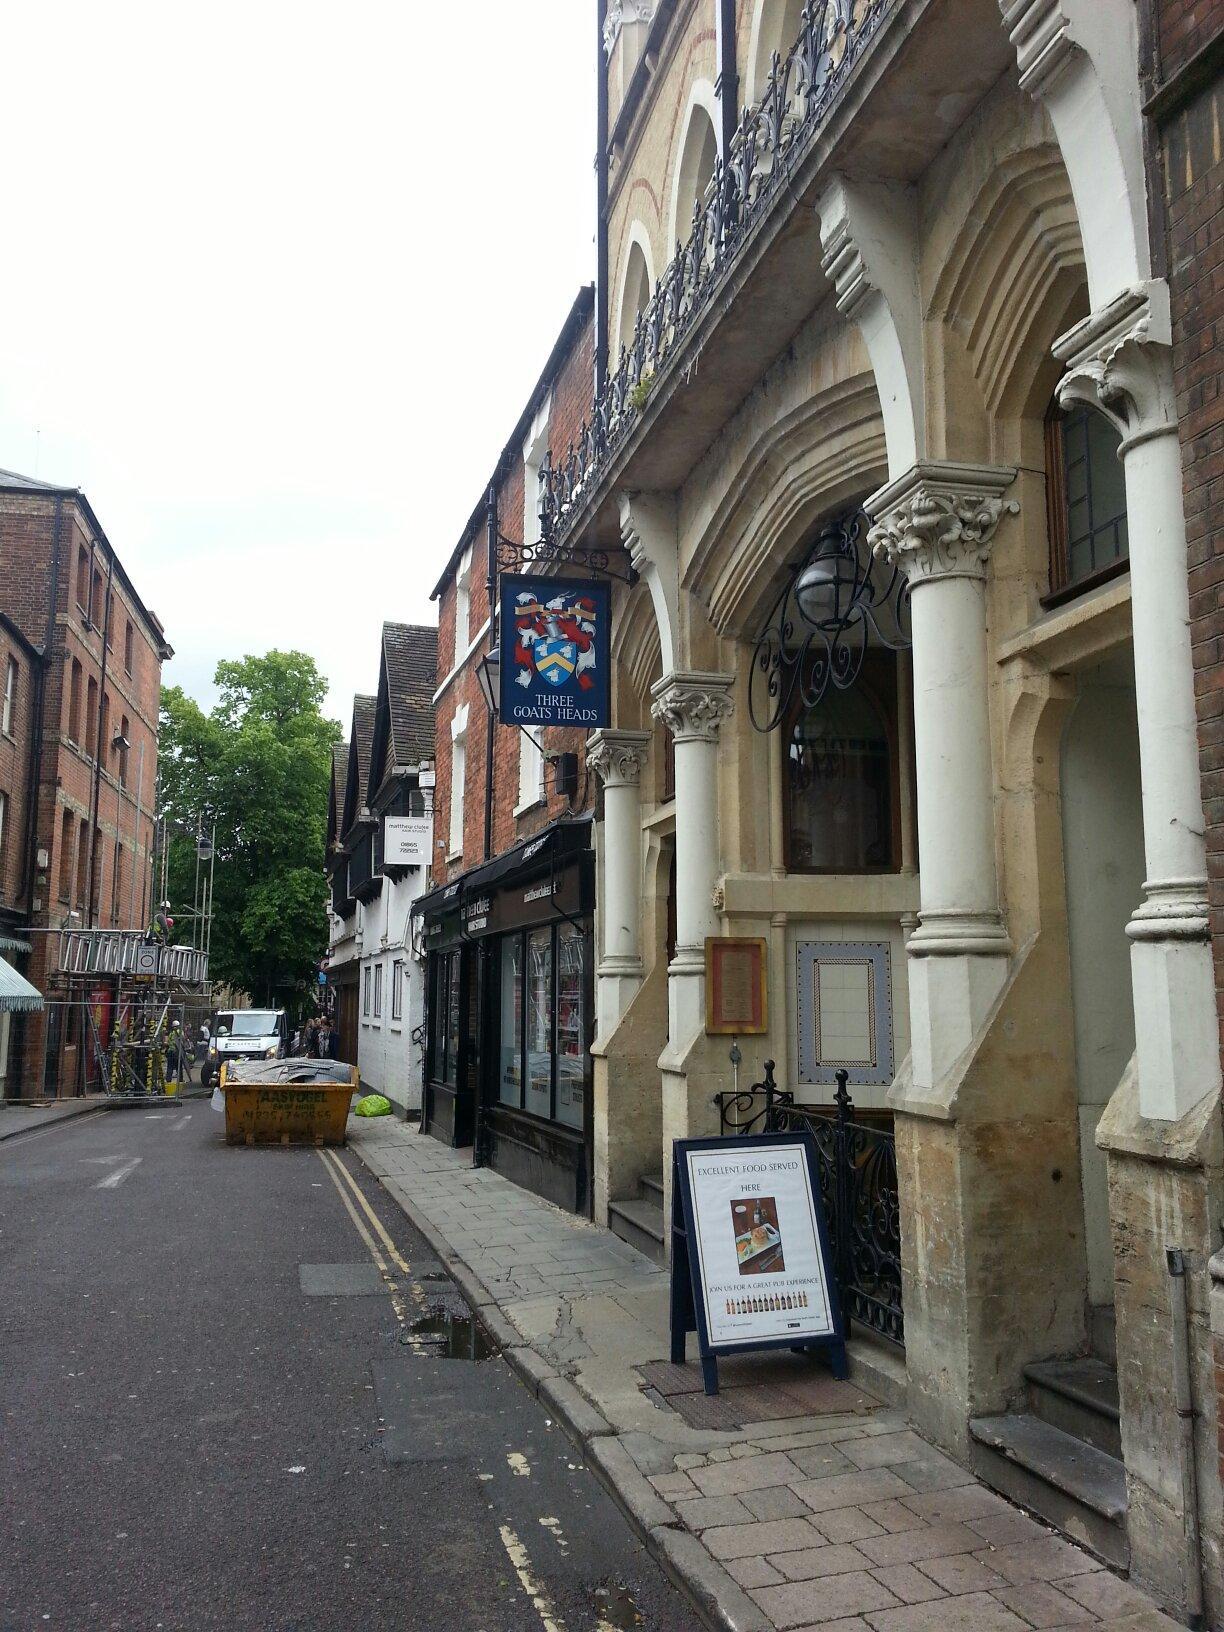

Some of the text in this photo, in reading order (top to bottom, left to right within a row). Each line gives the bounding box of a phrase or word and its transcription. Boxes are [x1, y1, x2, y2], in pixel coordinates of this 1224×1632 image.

[535, 694, 574, 707] THREE
[513, 706, 598, 721] GOATS HEADS
[697, 1161, 799, 1176] EXCELLENT FOOD SERVED
[740, 1184, 761, 1192] HERE
[786, 1277, 819, 1286] EXPERIENCE
